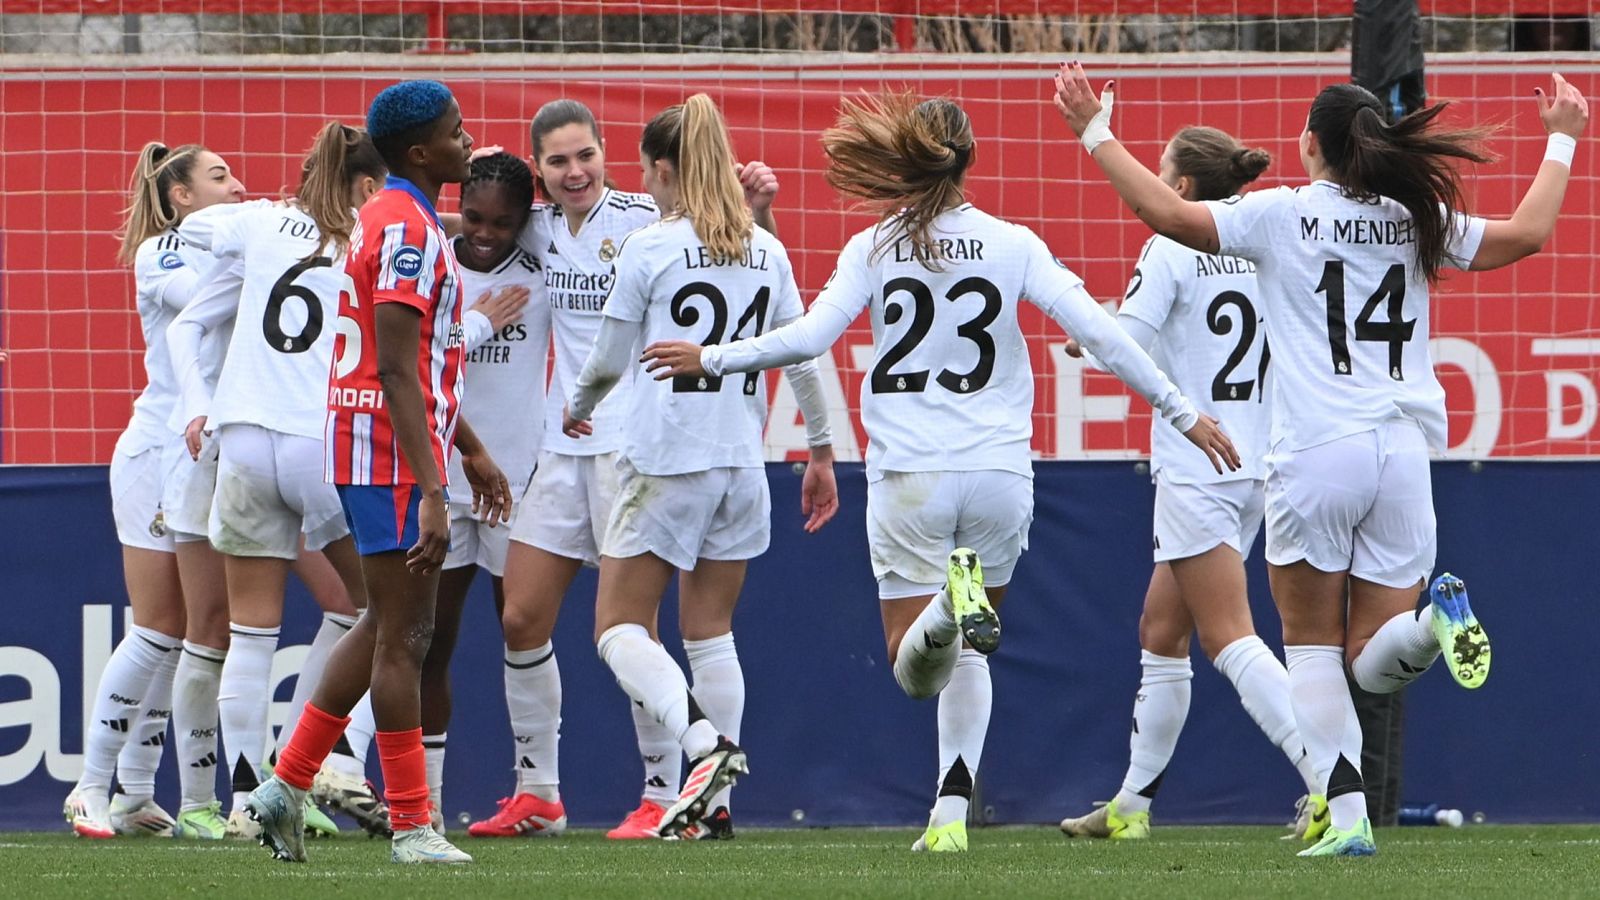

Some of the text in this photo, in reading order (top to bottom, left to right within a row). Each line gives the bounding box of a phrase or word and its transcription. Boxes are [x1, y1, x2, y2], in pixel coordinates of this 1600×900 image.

[279, 215, 317, 241] TOL
[1300, 216, 1324, 241] M.
[263, 256, 332, 353] 6
[546, 265, 612, 291] Emirate
[1315, 260, 1417, 381] 14
[670, 281, 770, 396] 24
[871, 276, 1003, 394] 23
